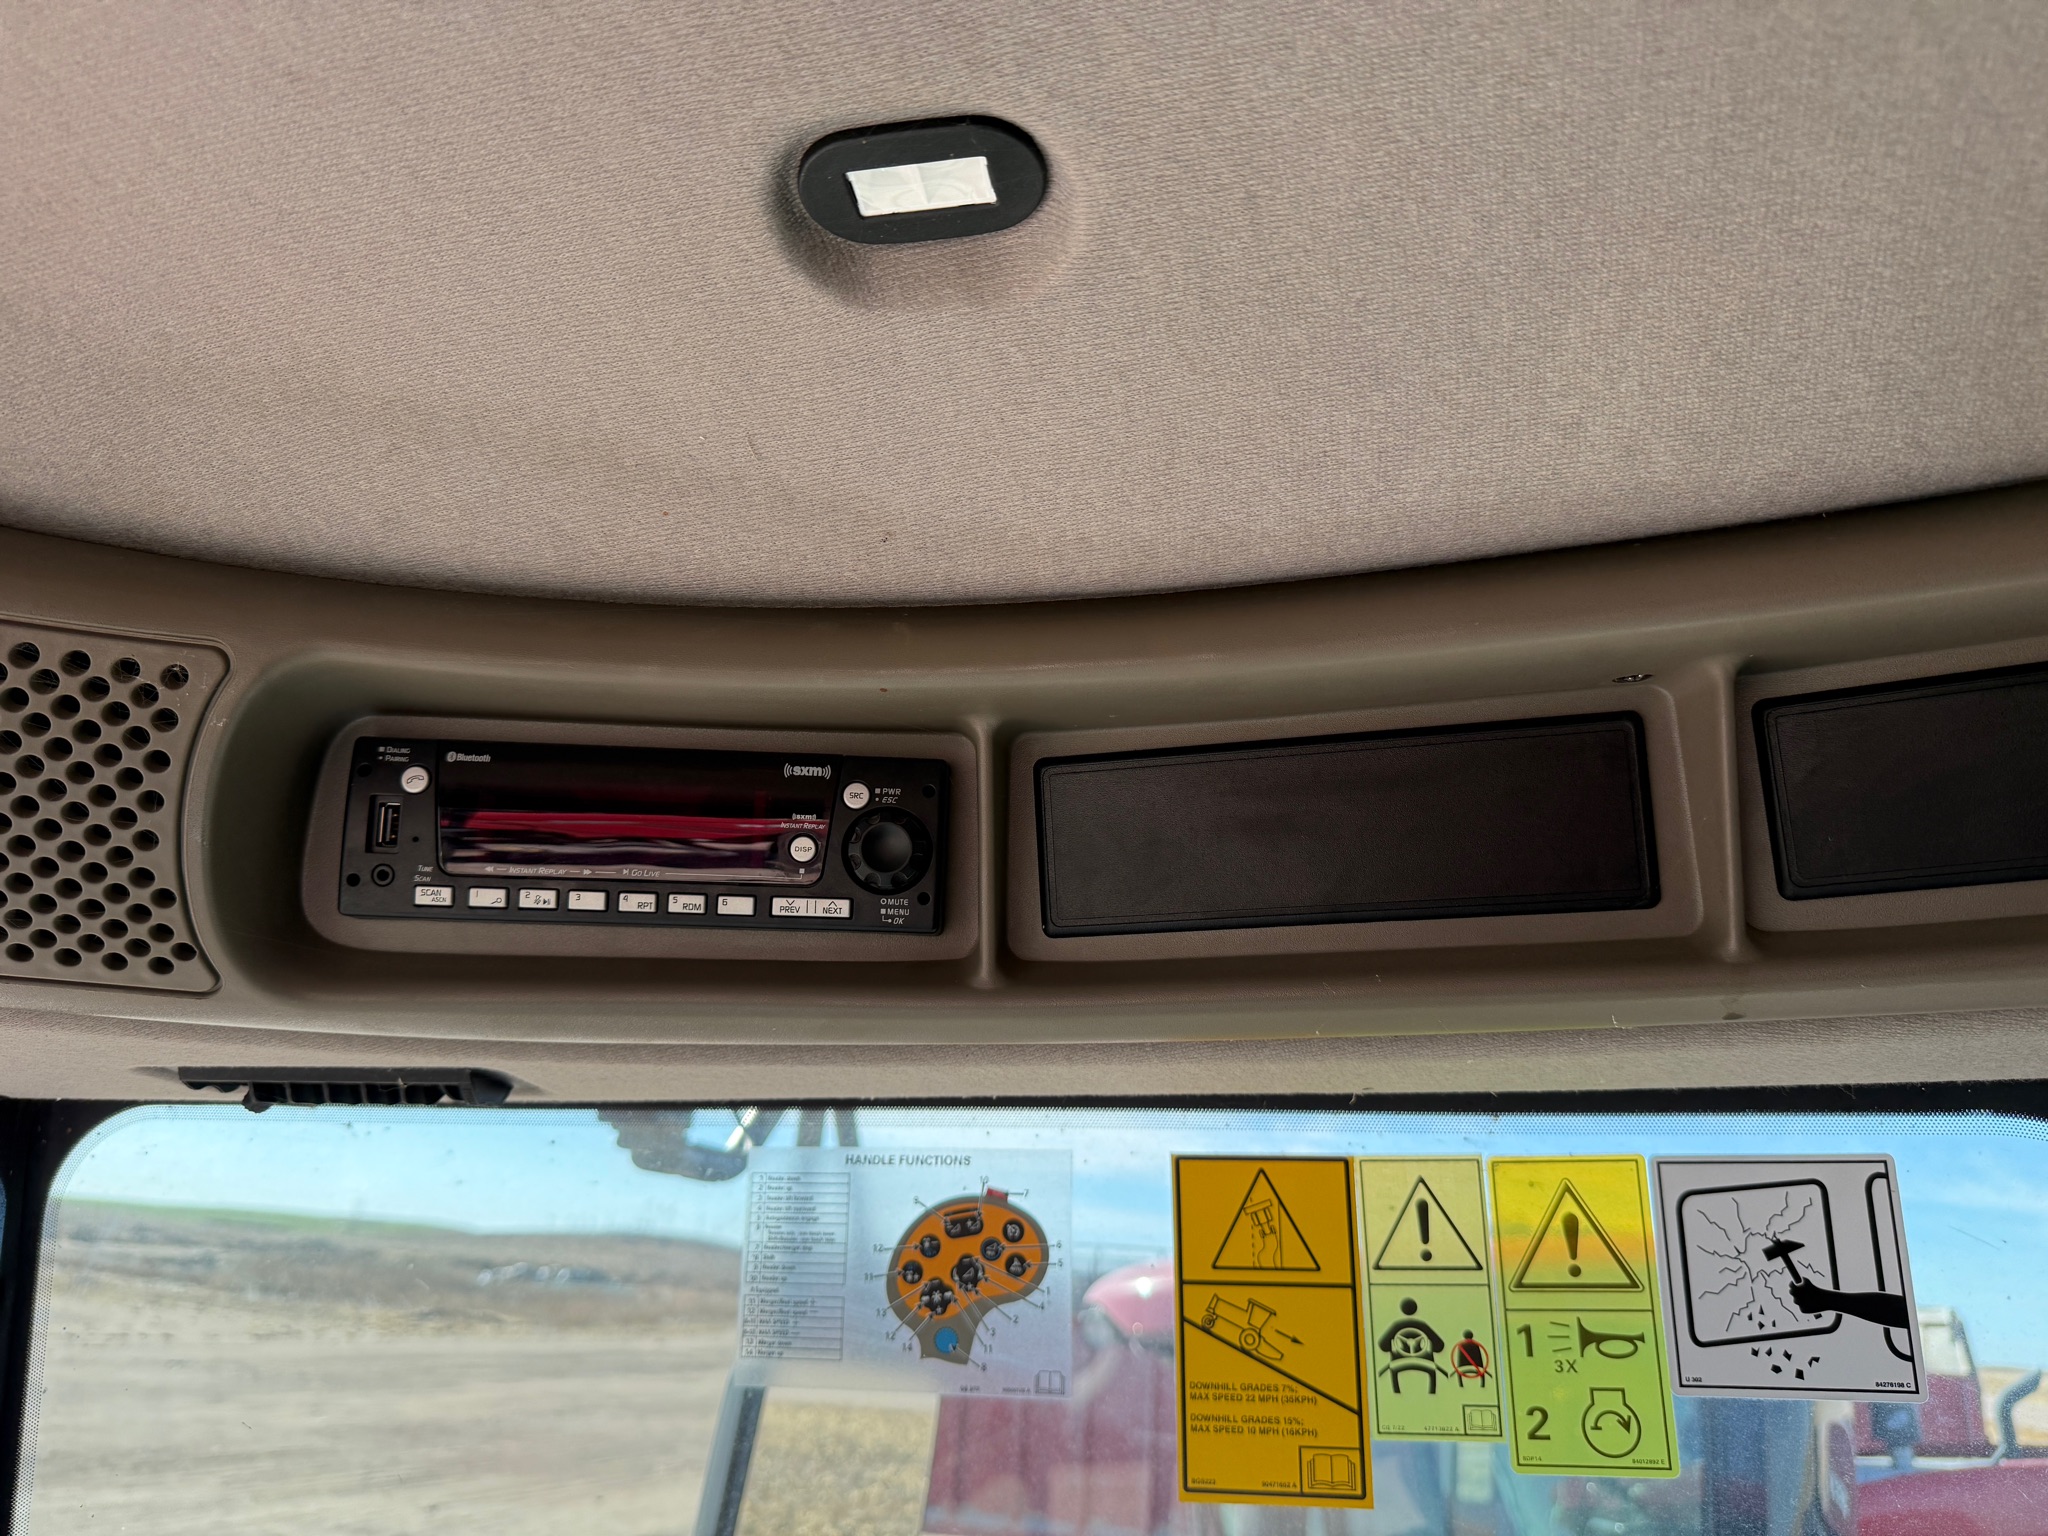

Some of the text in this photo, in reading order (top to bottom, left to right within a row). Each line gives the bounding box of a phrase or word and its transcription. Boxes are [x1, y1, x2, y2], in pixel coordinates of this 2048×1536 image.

[457, 753, 491, 763] Bluetooth
[508, 866, 537, 874] INSTANT
[538, 867, 567, 875] REPLAY
[420, 889, 442, 897] SCAN
[525, 891, 531, 899] 2
[575, 893, 581, 901] 3
[622, 894, 629, 902] 4
[672, 896, 678, 904] 5
[637, 902, 653, 910] RPT
[682, 903, 702, 911] RDM
[822, 907, 842, 915] NEXT
[893, 917, 905, 925] OK
[845, 1154, 972, 1166] HANDLE FUNCTIONS
[873, 1243, 884, 1252] 12
[1012, 1315, 1019, 1323] 2
[886, 1332, 896, 1340] 12
[1516, 1323, 1534, 1357] 1
[1554, 1359, 1578, 1373] 3X
[1189, 1381, 1237, 1391] DOWNHILL
[1240, 1382, 1279, 1392] GRADES
[1190, 1392, 1209, 1400] MAX
[1212, 1392, 1243, 1401] SPEED
[1258, 1394, 1278, 1402] MPH
[1190, 1413, 1238, 1423] DOWNHILL
[1241, 1415, 1280, 1424] GRADES
[1526, 1406, 1551, 1440] 2
[1190, 1424, 1210, 1433] MAX
[1212, 1425, 1244, 1434] SPEED
[1259, 1426, 1279, 1435] MPH
